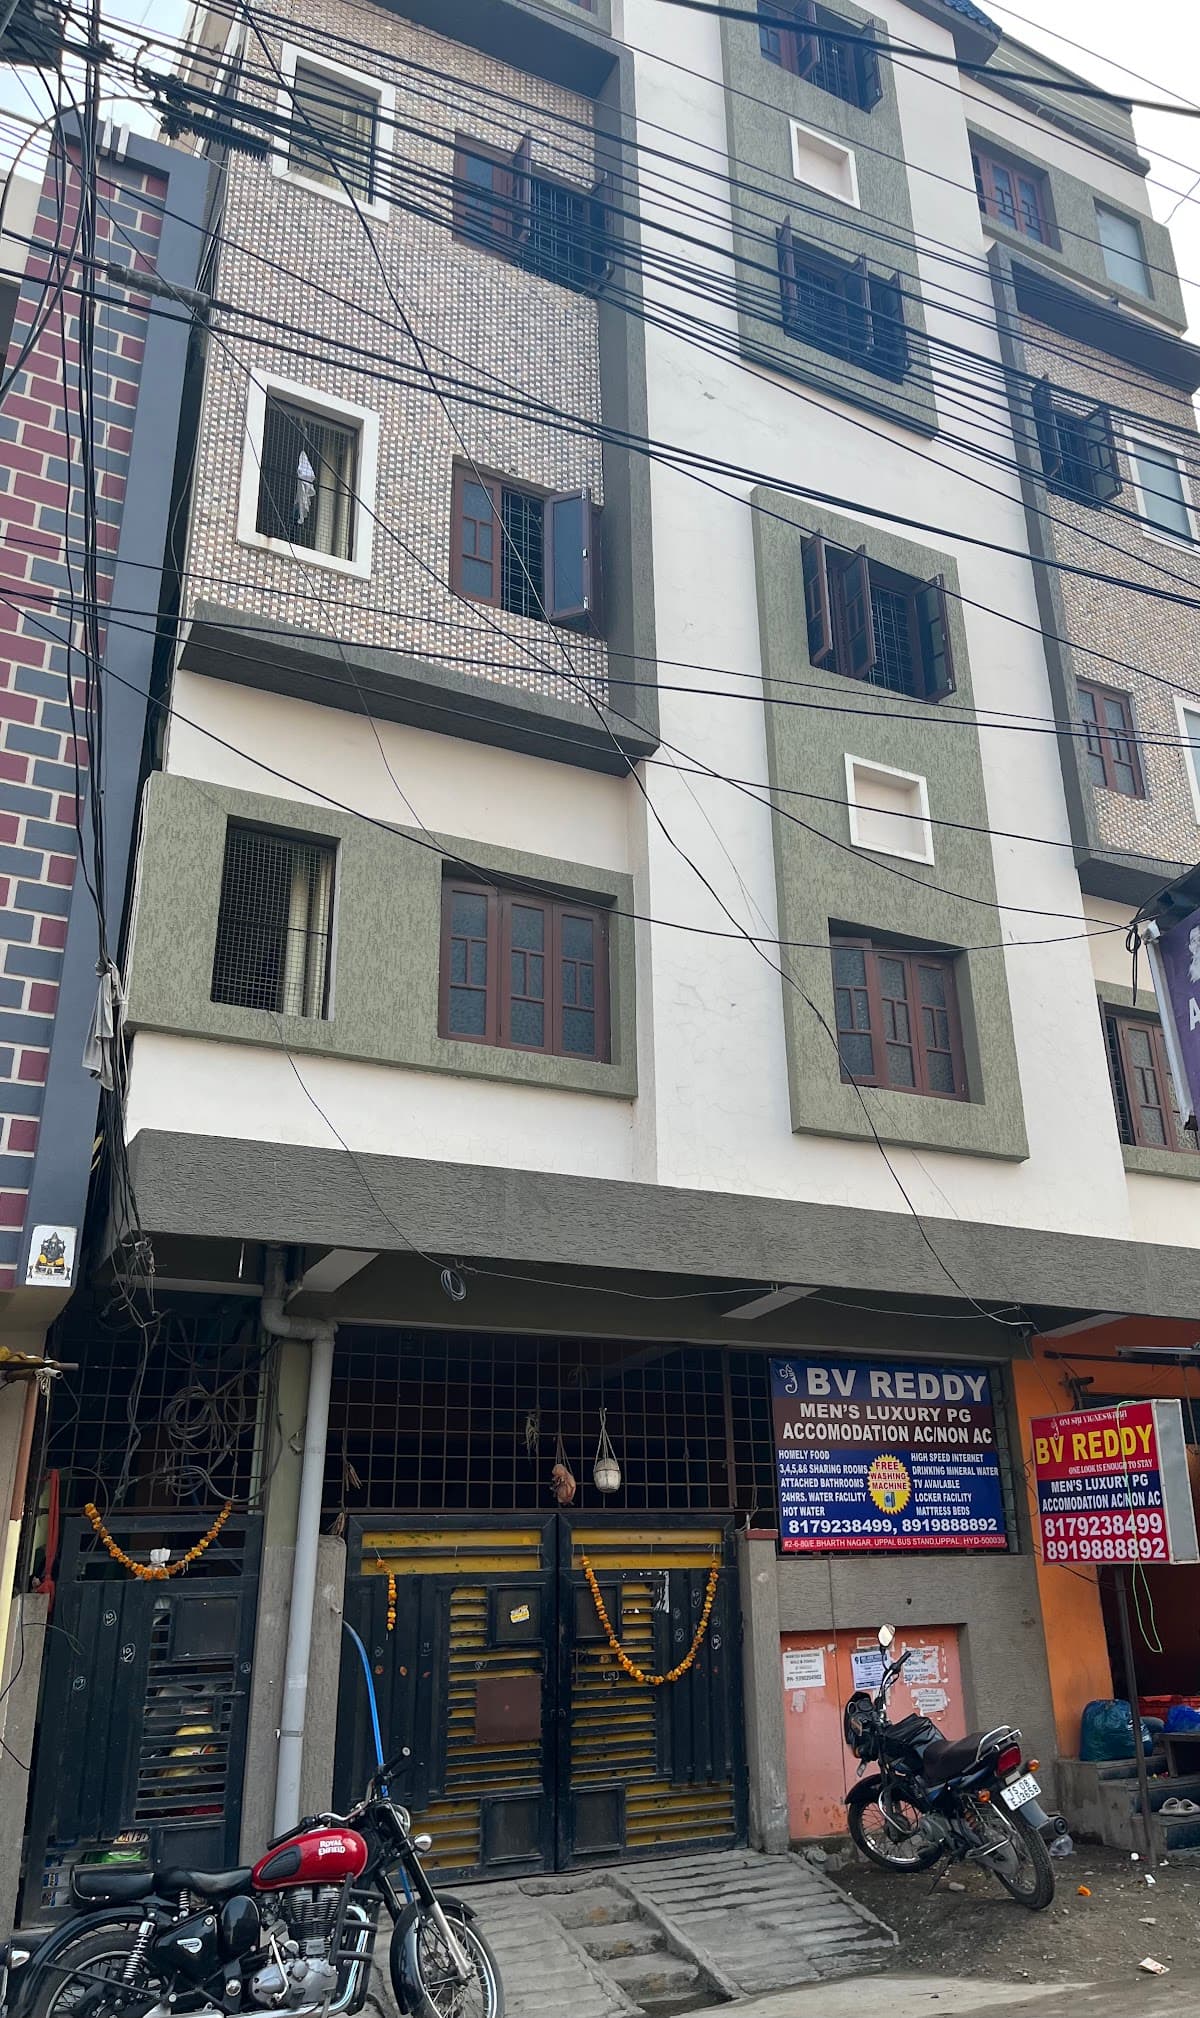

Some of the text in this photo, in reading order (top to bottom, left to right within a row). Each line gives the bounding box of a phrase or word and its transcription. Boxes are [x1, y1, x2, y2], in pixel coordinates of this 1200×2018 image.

[806, 1368, 986, 1402] BV REDDY
[800, 1403, 972, 1422] MEN'S LUXURY PG
[1060, 1417, 1070, 1426] OM
[783, 1423, 992, 1444] ACCOMODATION AC/NON AC
[1035, 1424, 1152, 1464] BV REDDY
[779, 1450, 830, 1459] HOMELY FOOD
[911, 1453, 983, 1462] HIGH SPEED INTERNET
[809, 1465, 841, 1474] SHARING
[876, 1462, 898, 1470] FREE
[912, 1466, 999, 1476] DRINKING MINERAL WATER
[1068, 1466, 1080, 1474] ONE
[1081, 1465, 1096, 1474] LOOK
[1128, 1461, 1136, 1469] TO
[1137, 1459, 1152, 1468] STAY
[781, 1478, 864, 1488] ATTACHED BATHROOMS
[914, 1480, 960, 1488] TV AVAILABLE
[1051, 1474, 1148, 1493] MEN'S LUXURY PG
[782, 1492, 866, 1502] 24HRS. WATER FACILITY
[915, 1493, 972, 1502] LOCKER FACILITY
[1042, 1491, 1160, 1512] ACCOMODATION AC/NON AC
[783, 1507, 825, 1516] HOT WATER
[916, 1506, 970, 1516] MATTRESS BEDS
[789, 1519, 997, 1534] 8179238499, 8919888892
[1044, 1513, 1162, 1537] 8179238499
[1047, 1538, 1166, 1559] 8919888892
[320, 1840, 342, 1848] ROYAL
[318, 1846, 346, 1856] ENFIELD
